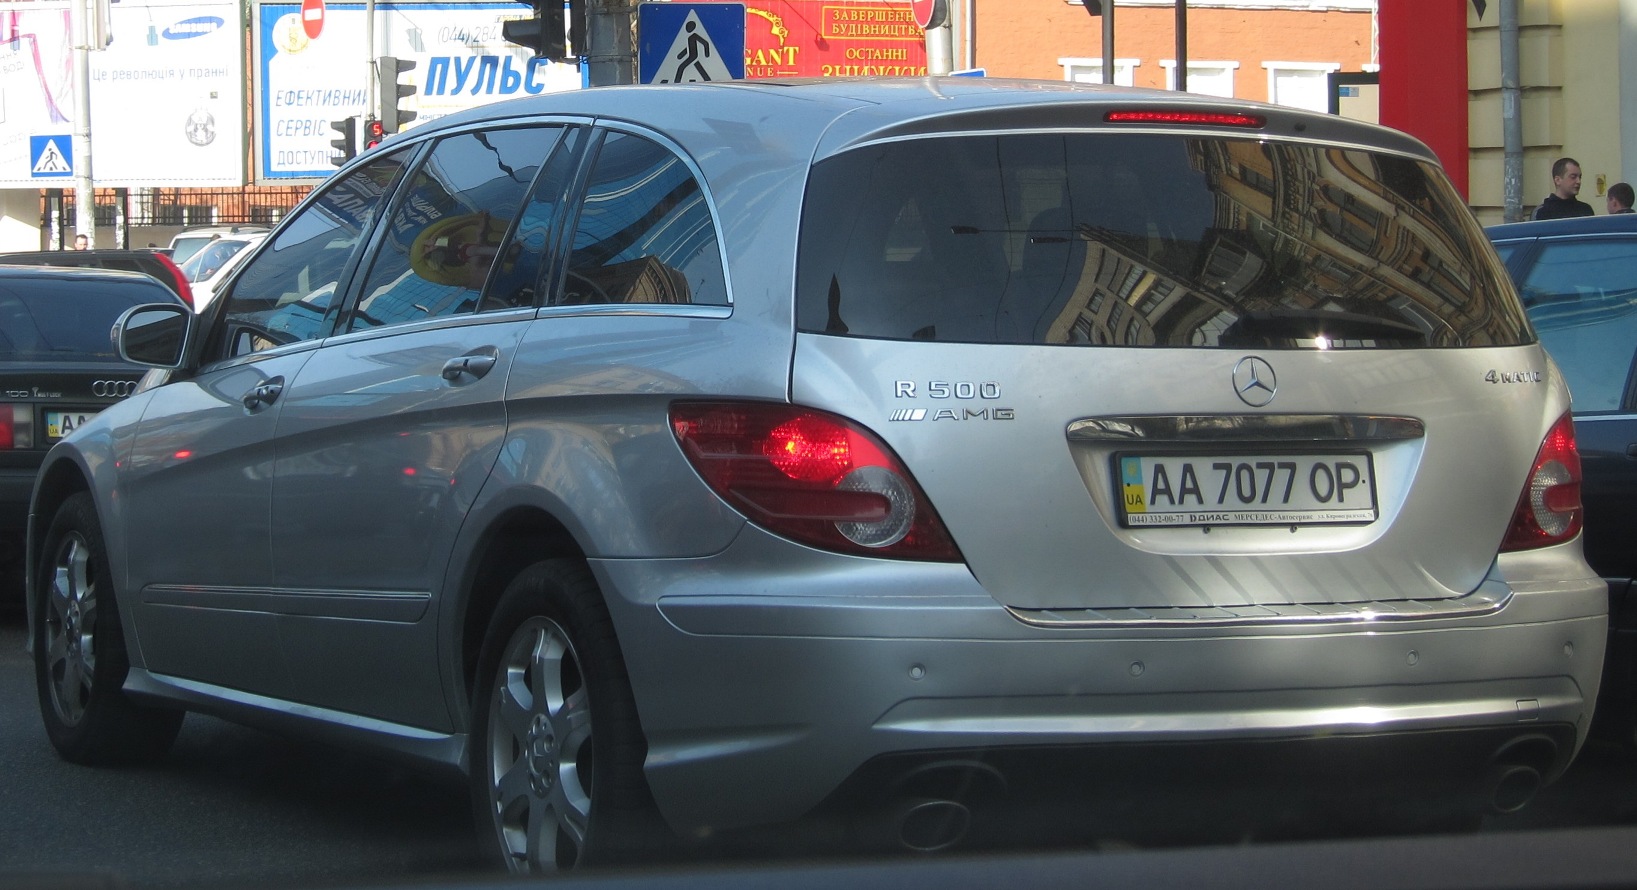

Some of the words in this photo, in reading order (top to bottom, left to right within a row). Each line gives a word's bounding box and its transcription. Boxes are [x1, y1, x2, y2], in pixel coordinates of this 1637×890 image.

[832, 9, 915, 22] ЗАВЕРШЕНН
[168, 21, 219, 35] SAMSUNG
[832, 23, 924, 37] БУДІВНИЦТВА
[437, 26, 470, 45] (044)
[473, 26, 497, 43] 284
[845, 47, 907, 61] ОСТАННІ
[92, 68, 108, 82] Це
[111, 66, 175, 83] революція
[178, 68, 186, 81] у
[189, 65, 229, 80] пранні
[424, 55, 549, 97] ПУЛЬС
[276, 119, 327, 137] СЕРВІС
[372, 124, 381, 135] 5
[5, 390, 29, 398] 100
[894, 380, 917, 399] R
[928, 380, 1001, 400] 500
[932, 407, 1015, 421] AMG
[1126, 494, 1143, 506] UA
[1150, 463, 1204, 506] AA
[1212, 461, 1297, 505] 7077
[1309, 461, 1361, 503] OP
[1129, 514, 1148, 524] (044)
[1149, 514, 1184, 524] 332-00-77
